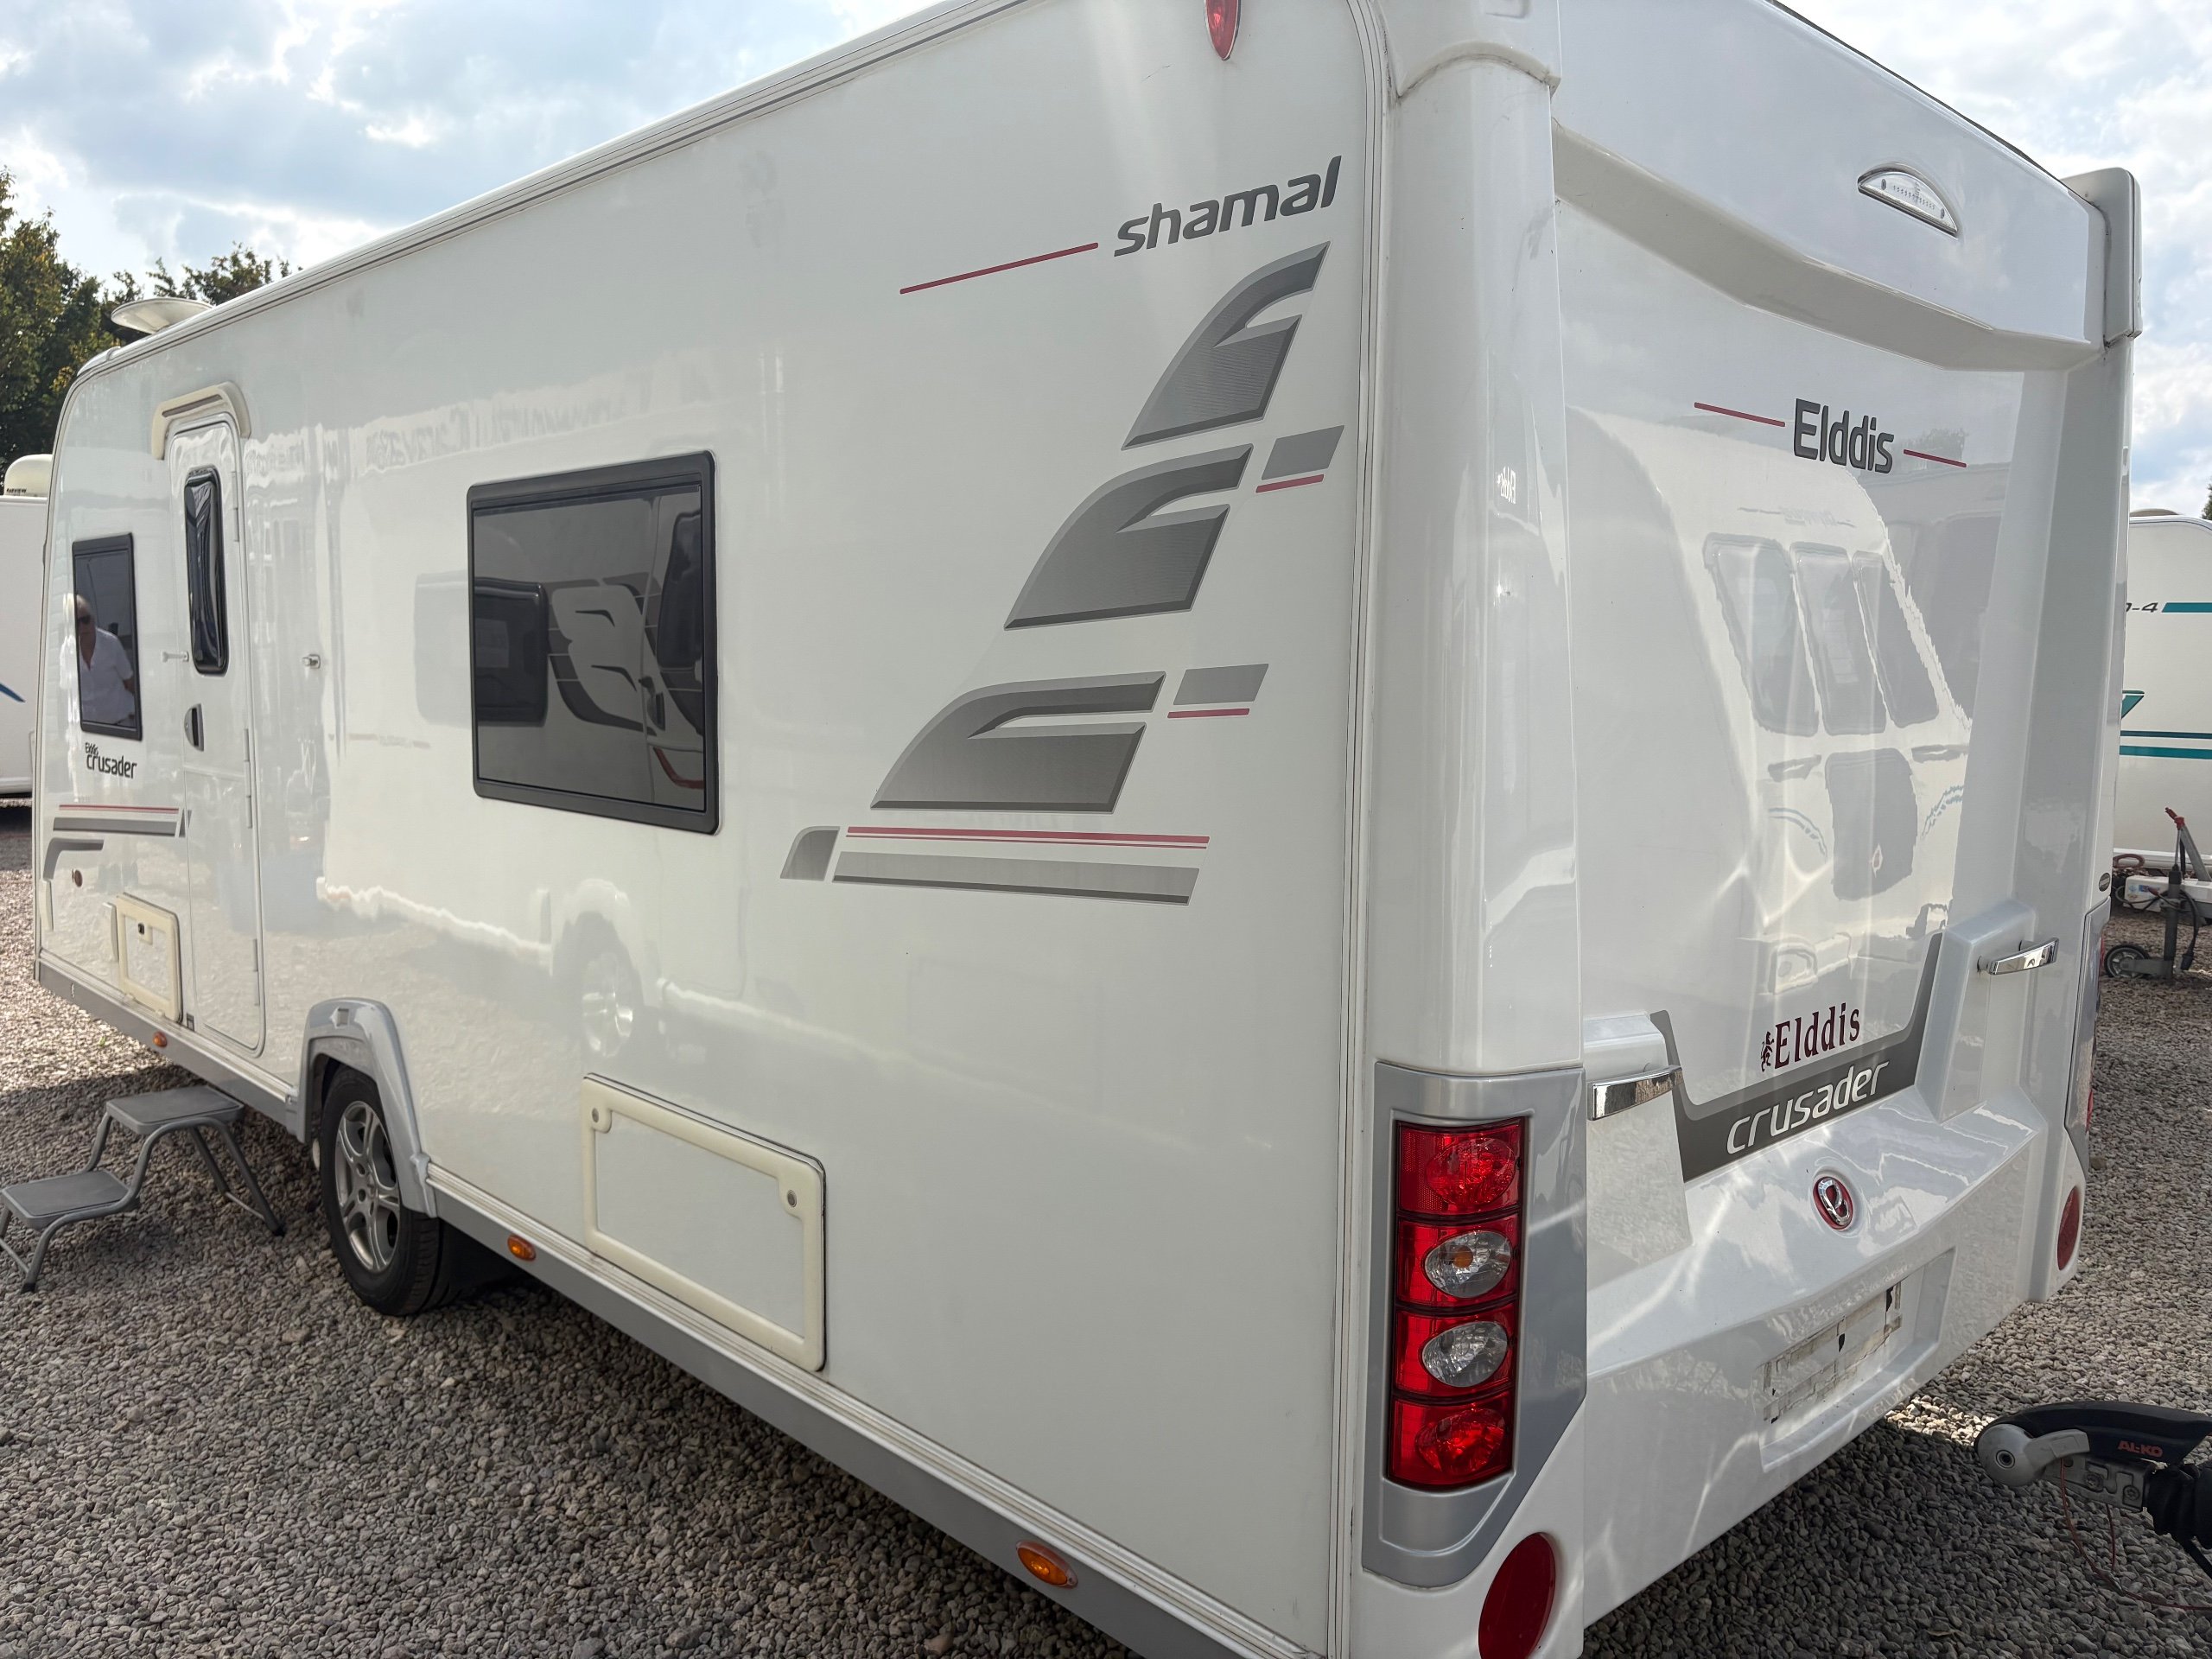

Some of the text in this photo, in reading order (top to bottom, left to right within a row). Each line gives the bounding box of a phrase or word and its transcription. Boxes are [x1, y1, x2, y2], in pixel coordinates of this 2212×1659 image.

[1113, 156, 1342, 257] shamal
[1793, 398, 1895, 474] Elddis
[86, 754, 137, 779] crusader
[1774, 1002, 1860, 1070] Elddis
[1726, 1061, 1889, 1155] crusader
[2117, 1440, 2163, 1458] AL-KO
